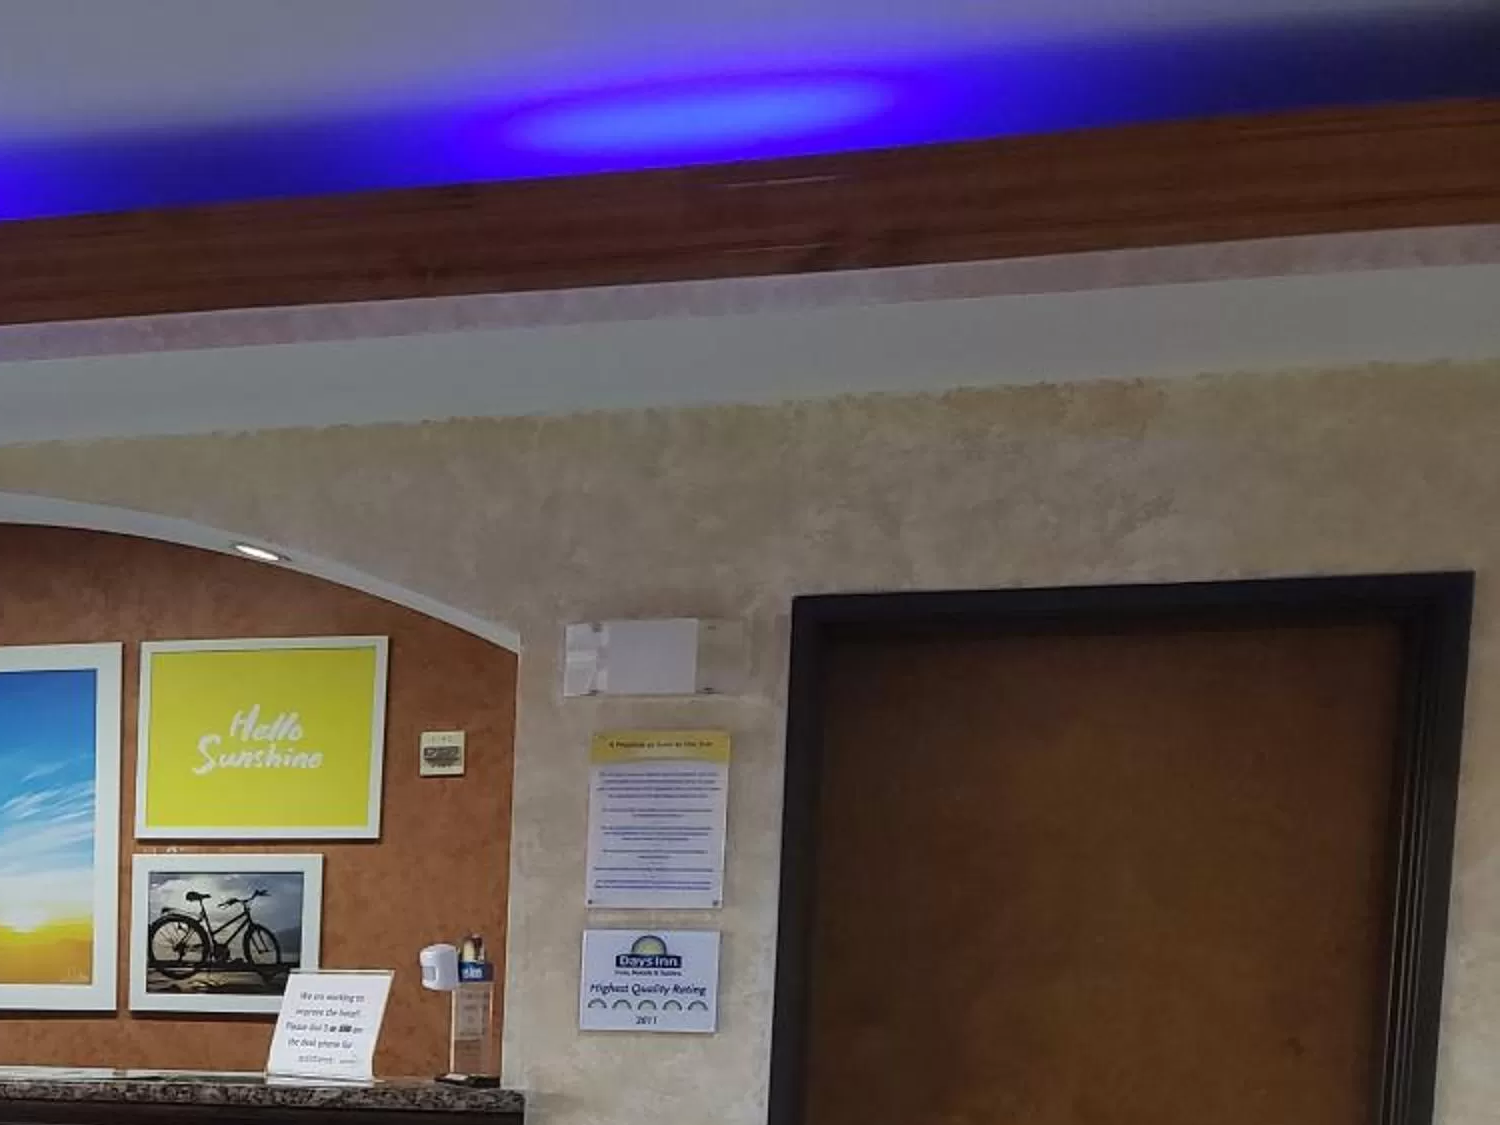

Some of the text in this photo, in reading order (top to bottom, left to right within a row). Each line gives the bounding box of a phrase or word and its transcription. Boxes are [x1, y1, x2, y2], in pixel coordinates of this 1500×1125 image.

[230, 704, 303, 742] Hello
[192, 734, 324, 775] Sunshine
[620, 955, 678, 967] Days Inn
[589, 982, 707, 997] Highest Quality Rating
[300, 991, 312, 1000] We
[326, 992, 355, 1003] working
[295, 1009, 324, 1017] improve
[325, 1008, 338, 1017] the
[285, 1021, 308, 1031] Please
[287, 1038, 299, 1047] the
